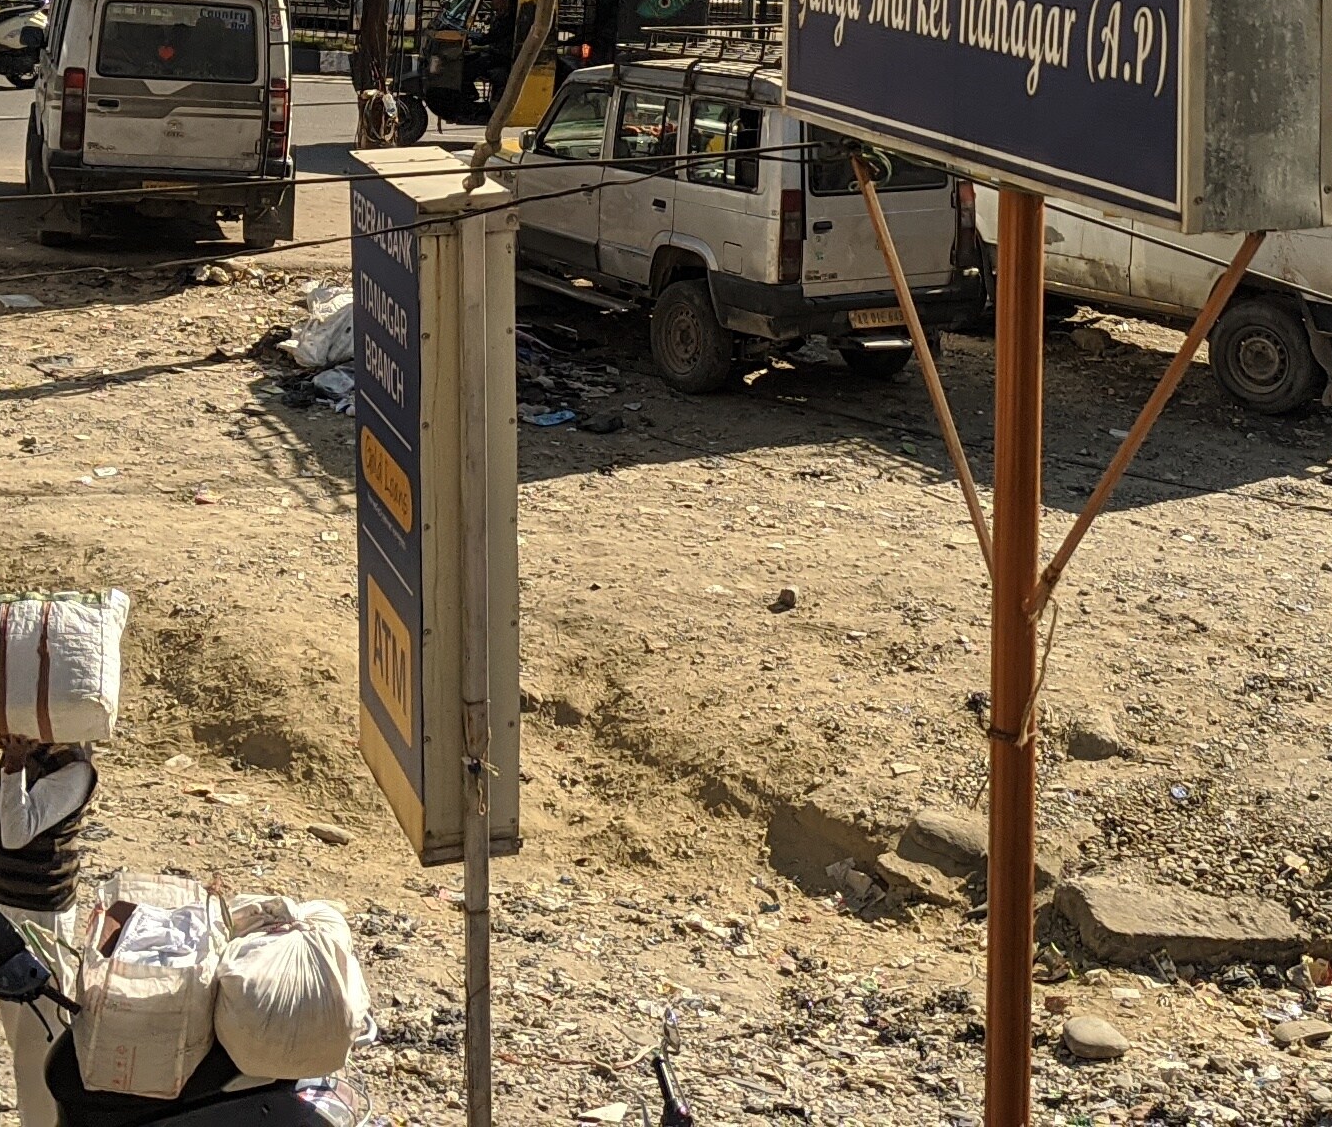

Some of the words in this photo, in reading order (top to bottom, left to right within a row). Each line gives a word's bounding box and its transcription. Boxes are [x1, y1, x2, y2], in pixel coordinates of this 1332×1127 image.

[353, 189, 387, 251] FEDERAL
[387, 216, 414, 274] BANK
[360, 270, 408, 350] ITANAGAR
[364, 333, 405, 408] BRANCH
[373, 607, 407, 716] ATM
